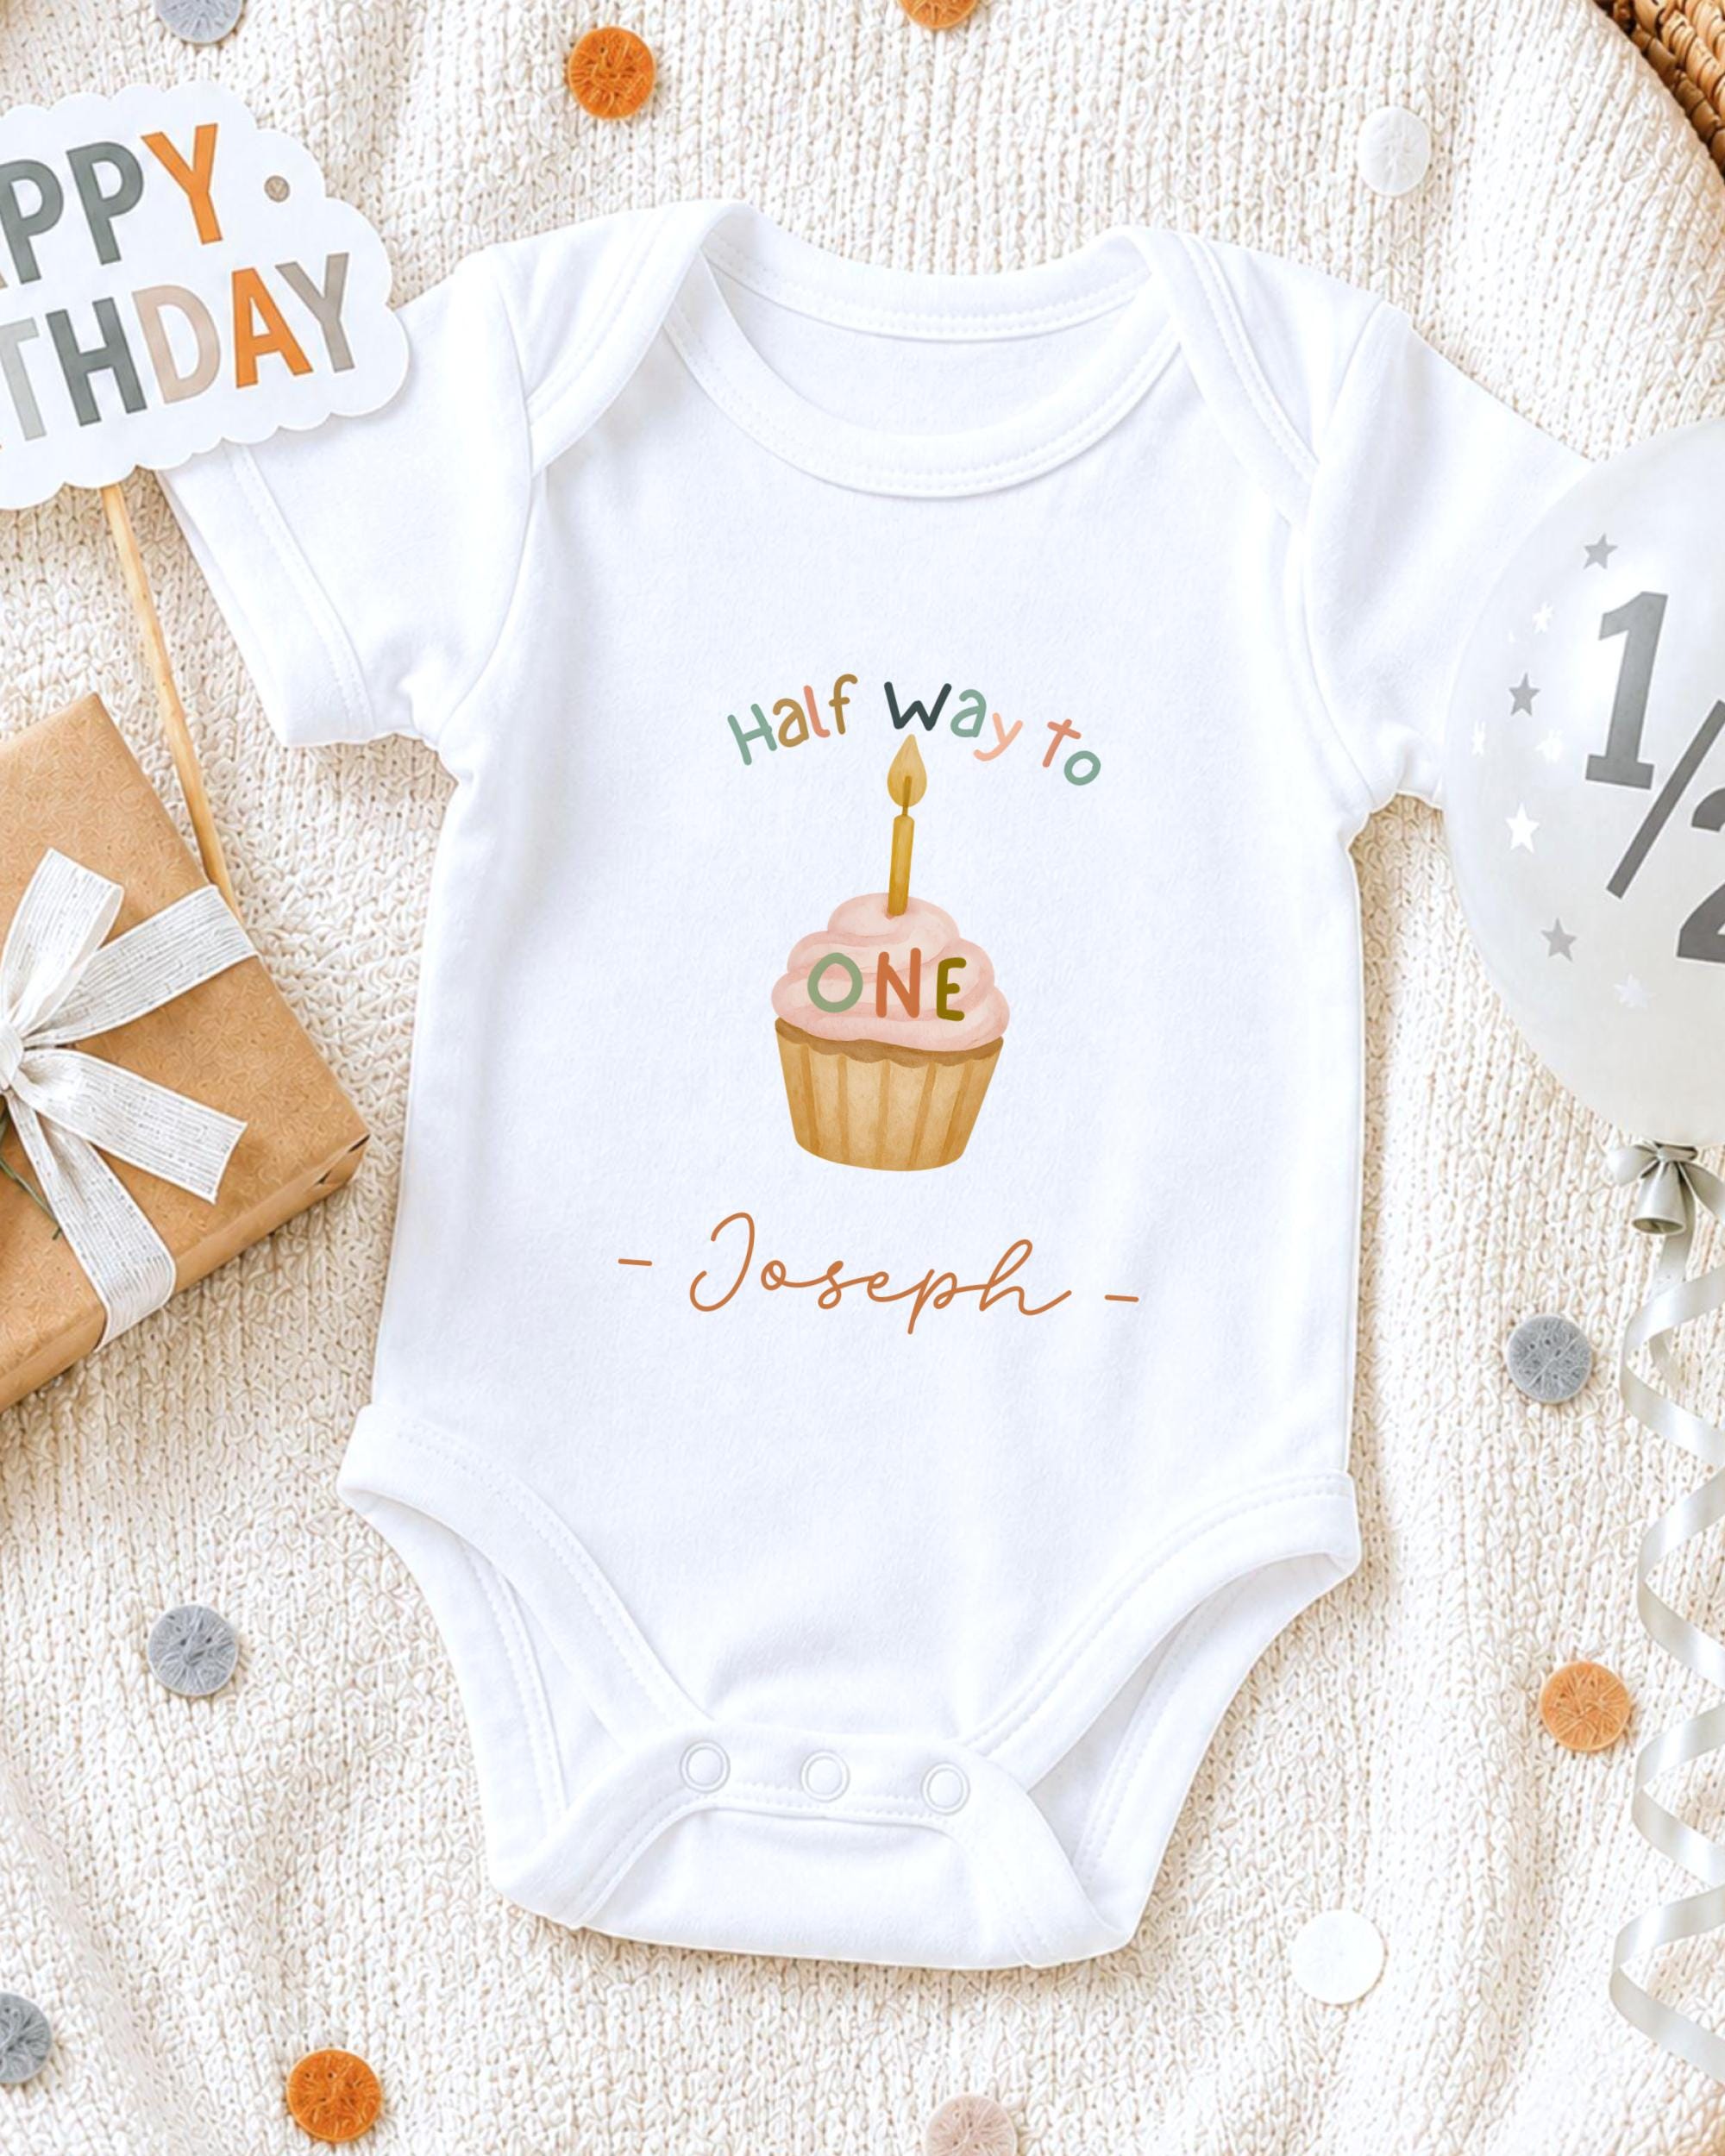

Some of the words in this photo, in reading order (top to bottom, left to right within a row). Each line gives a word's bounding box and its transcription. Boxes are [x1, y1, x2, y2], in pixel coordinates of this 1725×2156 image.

[0, 122, 223, 289] PPY
[0, 252, 356, 449] THDAY
[727, 673, 859, 766] Half
[883, 681, 1024, 762] Way
[1042, 718, 1102, 787] to
[807, 947, 968, 1022] ONE
[689, 1211, 1073, 1336] Joseph
